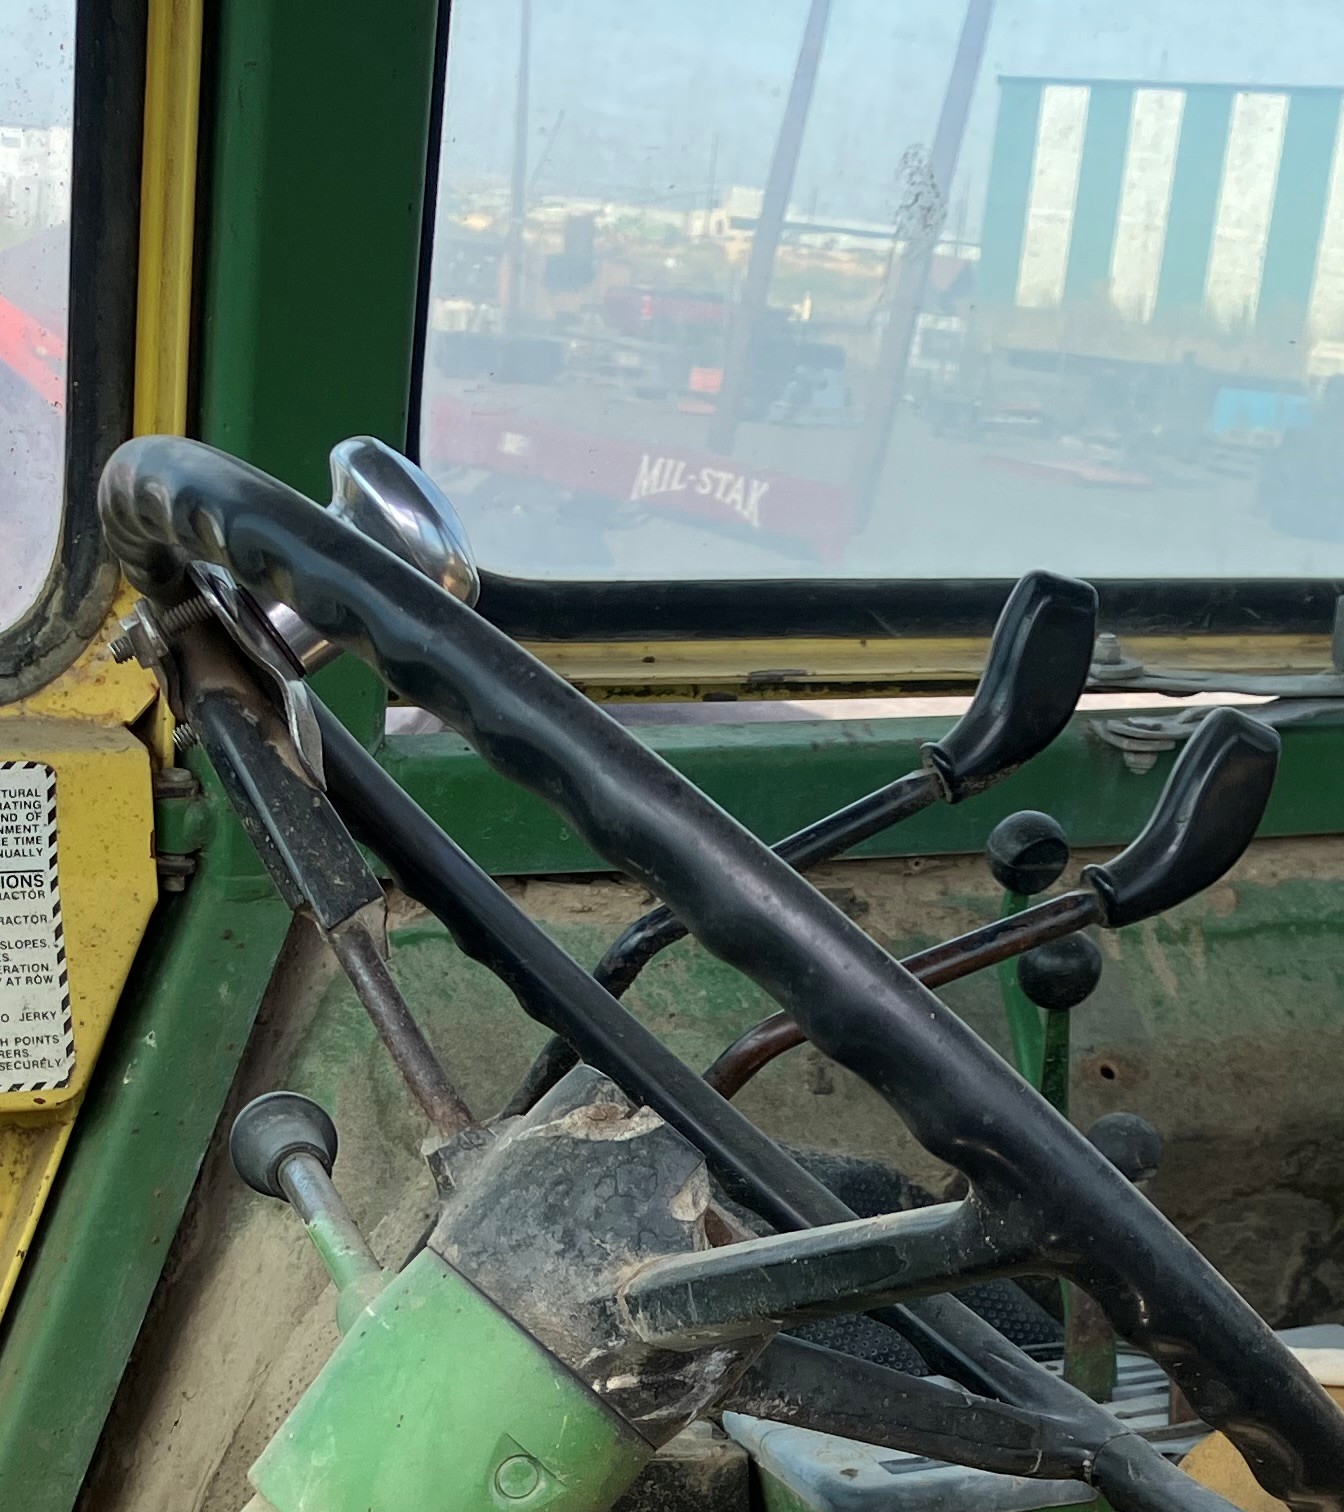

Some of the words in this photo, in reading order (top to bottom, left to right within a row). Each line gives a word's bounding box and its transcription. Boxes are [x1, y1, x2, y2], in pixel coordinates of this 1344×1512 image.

[630, 454, 770, 528] MIL-STAK
[26, 812, 42, 821] OF
[14, 836, 42, 845] TIME
[5, 976, 22, 985] AT
[25, 974, 54, 984] ROW
[19, 1011, 57, 1021] JERKY
[14, 1034, 60, 1046] POINTS
